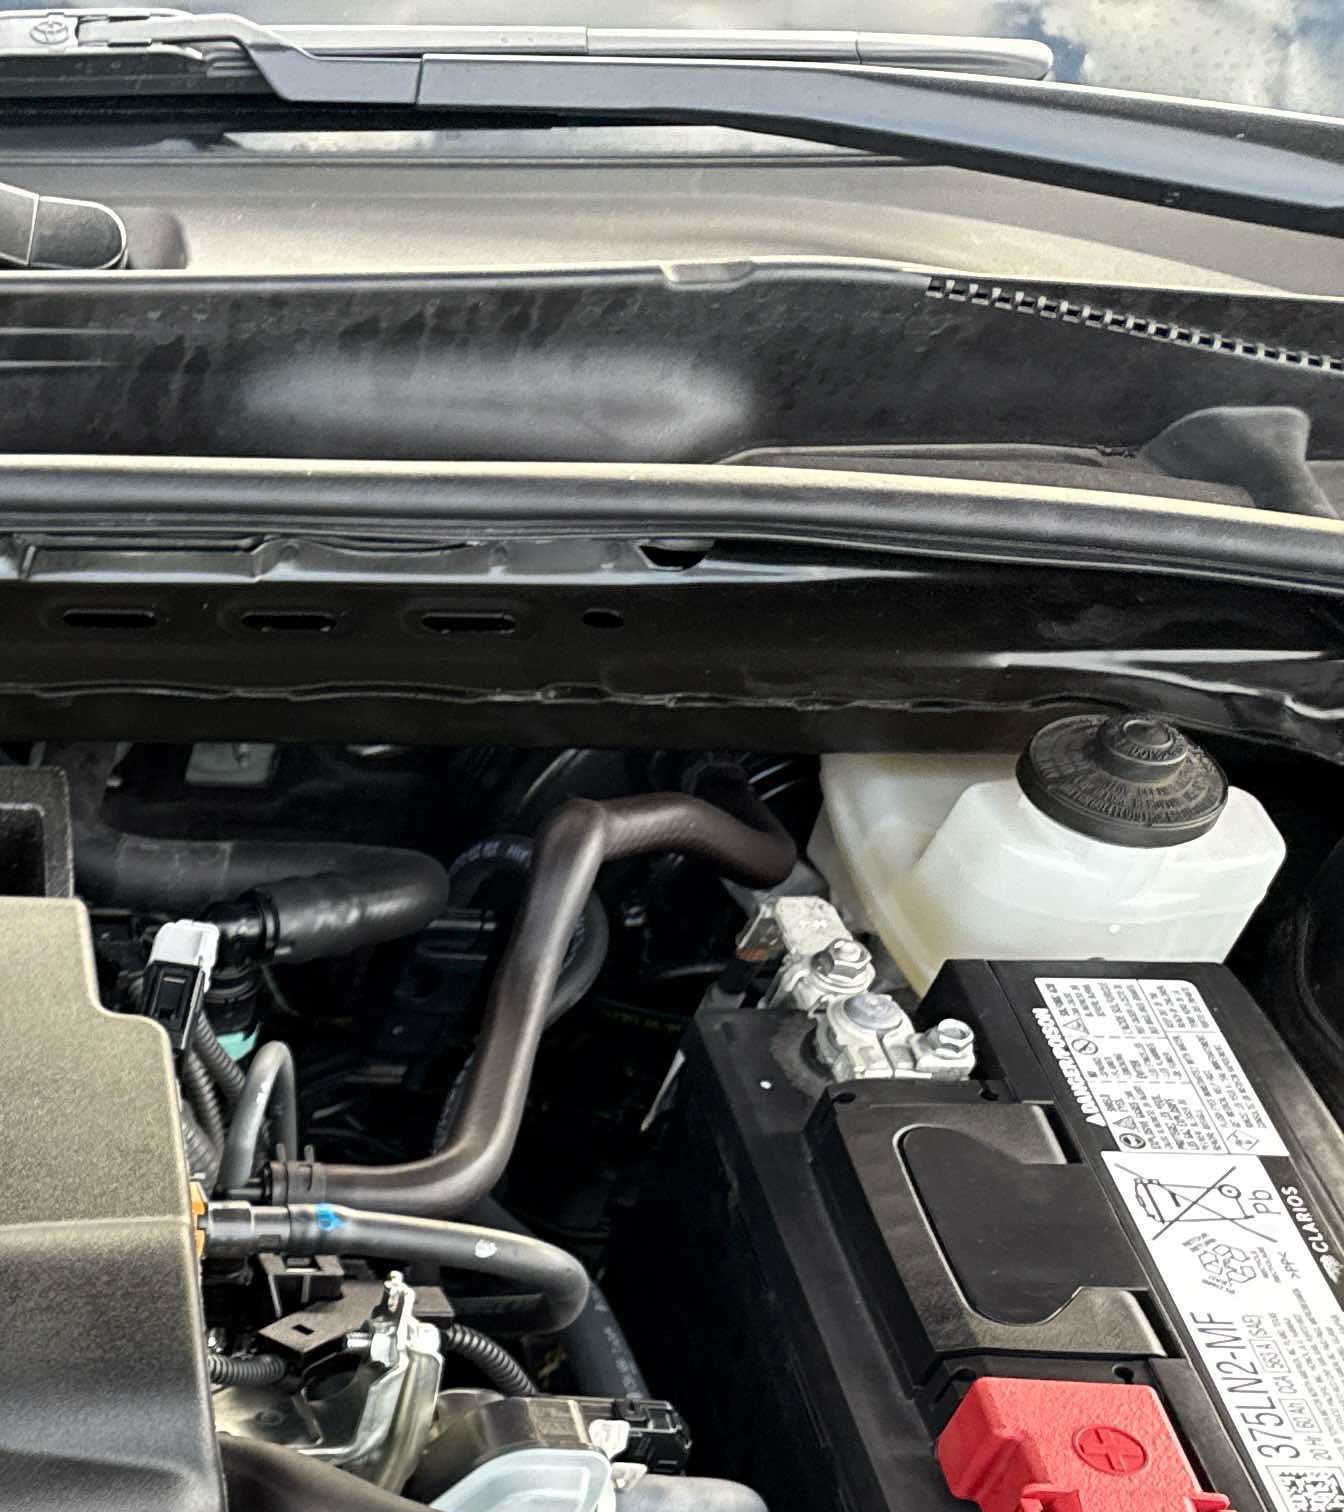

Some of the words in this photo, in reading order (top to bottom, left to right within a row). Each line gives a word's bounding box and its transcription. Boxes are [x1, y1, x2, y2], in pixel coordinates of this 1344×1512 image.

[1248, 1189, 1281, 1214] Pb
[1281, 1186, 1329, 1253] CLARIOS
[1190, 1312, 1301, 1459] 375LN2-MF
